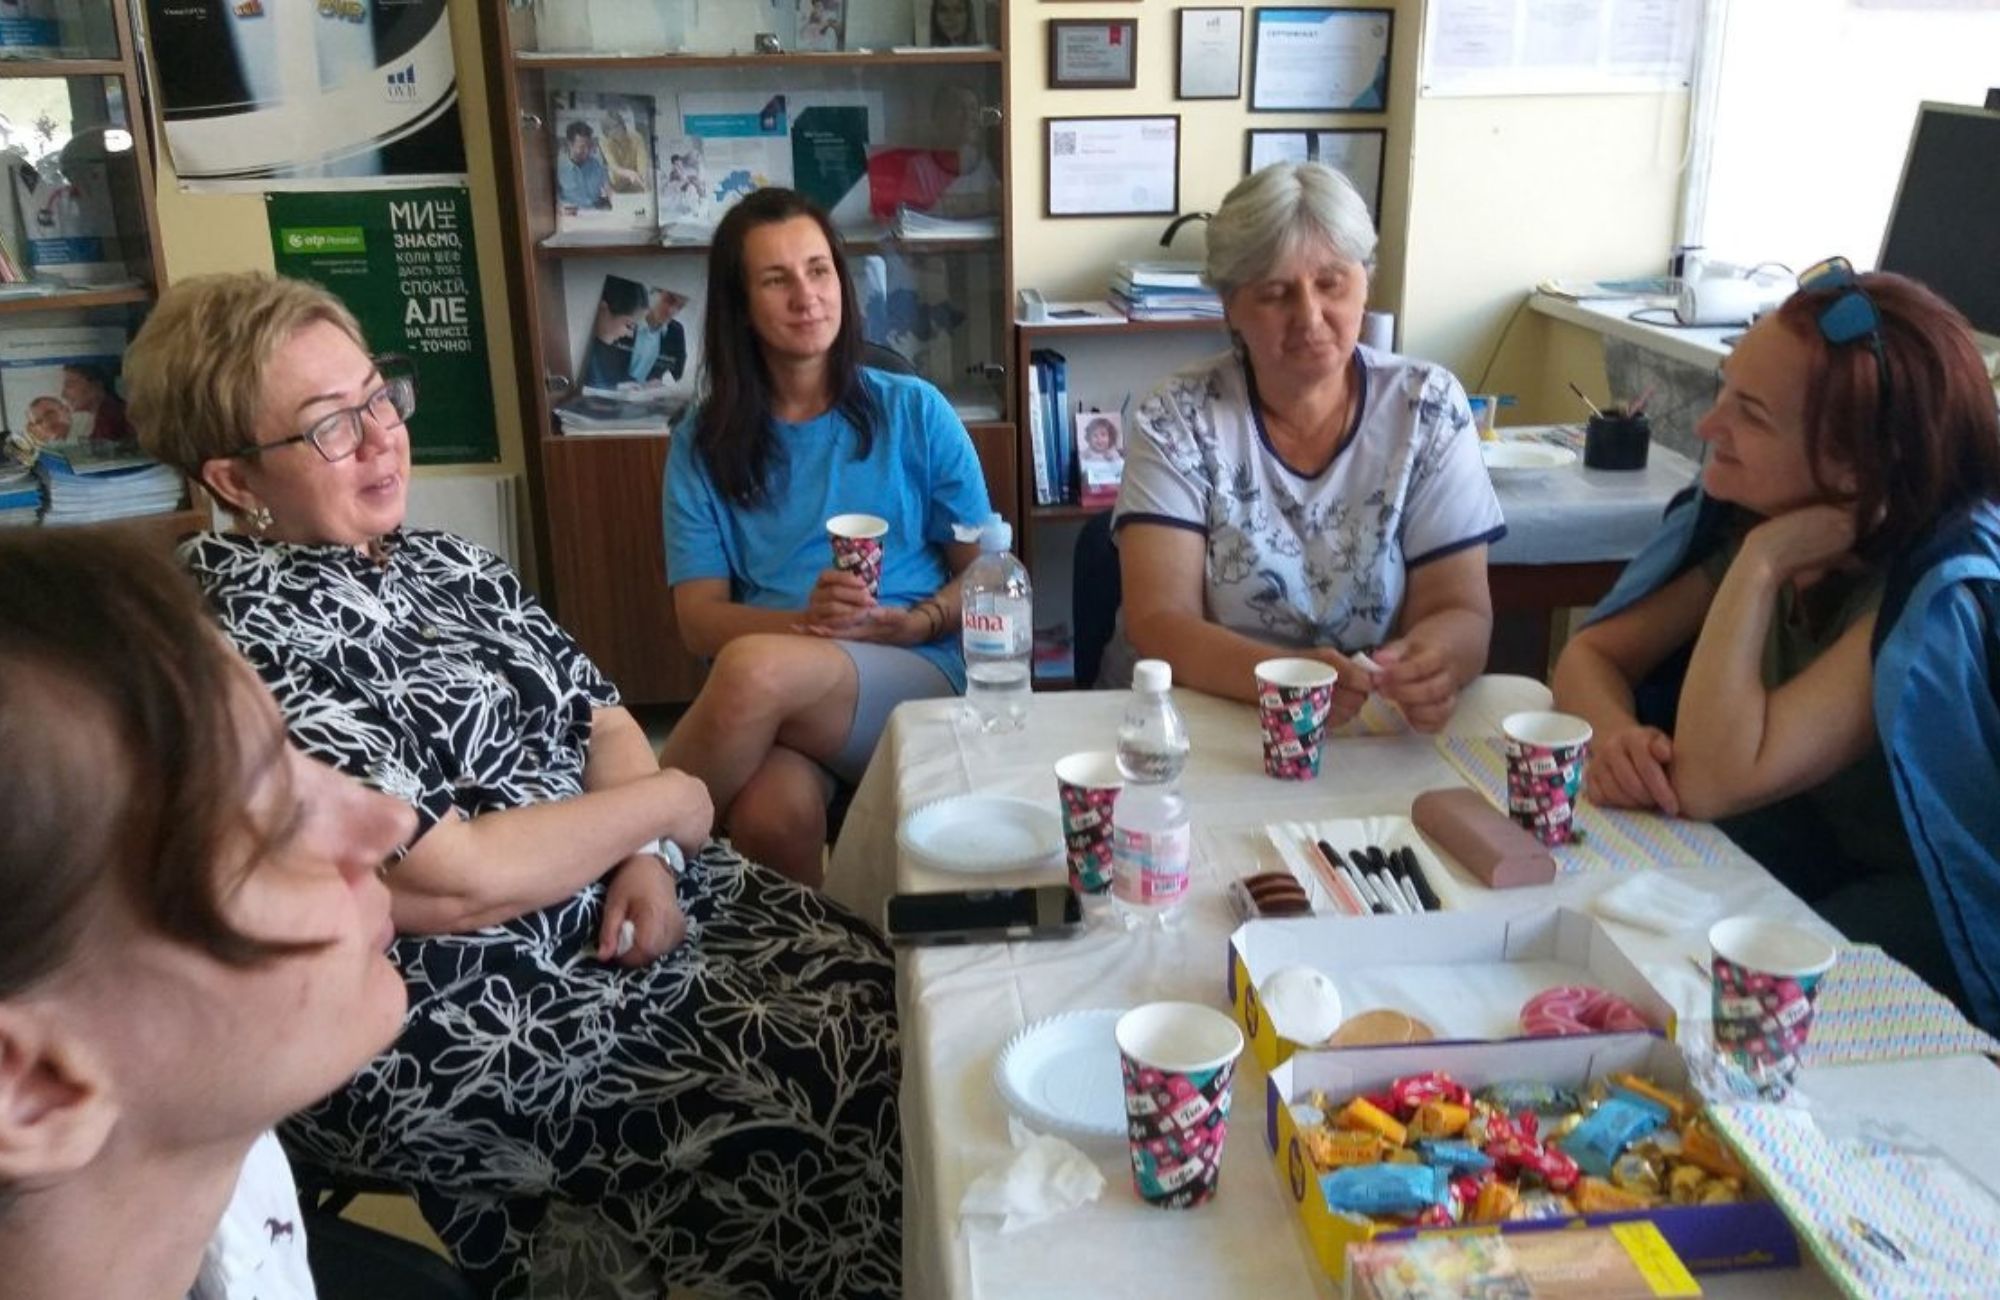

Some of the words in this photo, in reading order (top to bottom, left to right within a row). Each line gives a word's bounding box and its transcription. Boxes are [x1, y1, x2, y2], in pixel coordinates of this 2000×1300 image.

[389, 201, 435, 230] МИ
[435, 200, 457, 229] НЕ
[393, 232, 463, 250] ЗНАЄМО,
[396, 251, 430, 264] КОЛИ
[400, 277, 469, 296] СПОКІЙ,
[405, 297, 468, 325] АЛЕ
[405, 327, 421, 338] НА
[420, 339, 471, 353] ТОЧНО!
